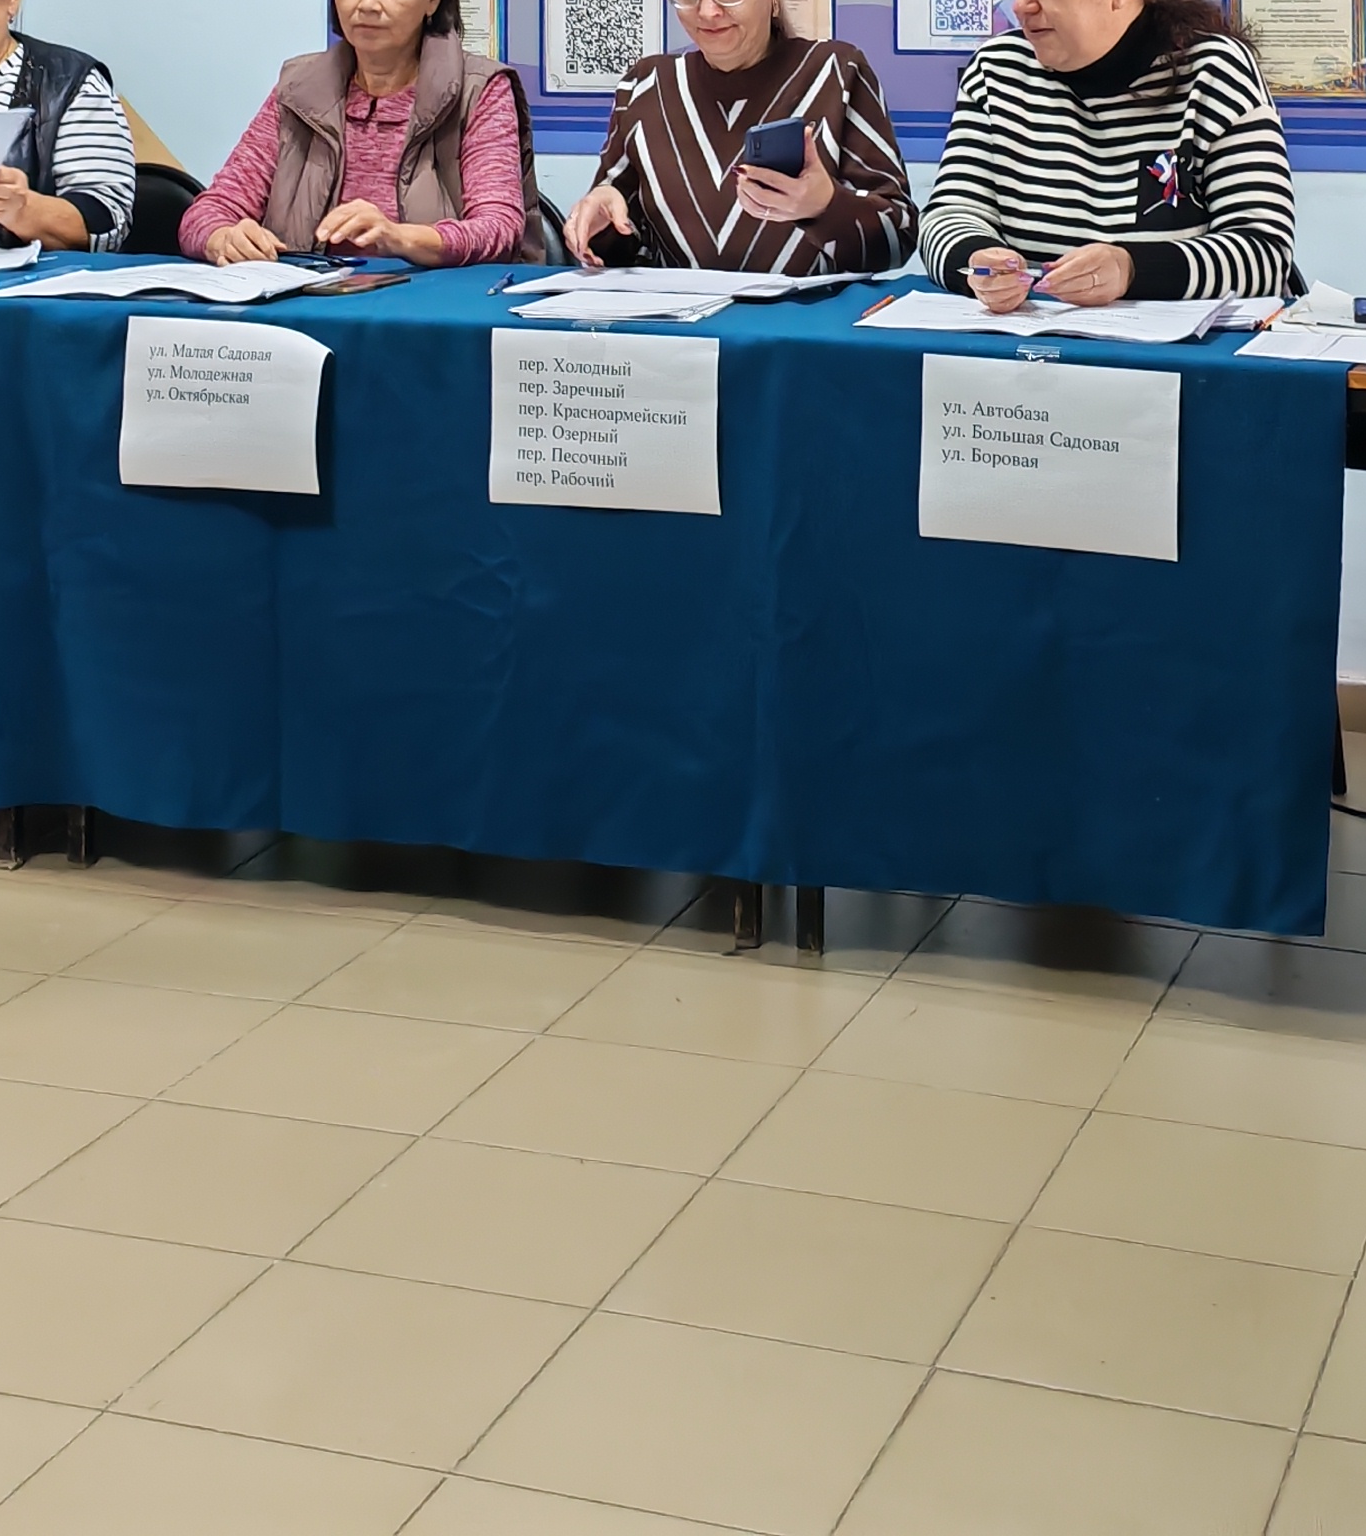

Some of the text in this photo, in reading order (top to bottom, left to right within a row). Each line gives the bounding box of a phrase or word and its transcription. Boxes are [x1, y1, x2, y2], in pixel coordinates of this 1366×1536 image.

[149, 344, 272, 361] ул. Малая Садовая
[148, 365, 253, 383] ул. Молодежная
[519, 358, 632, 376] пер. Холодный
[146, 387, 250, 406] ул. Октябрьская
[519, 380, 625, 399] пер. Заречный
[518, 402, 687, 426] пер. Красноармейский
[942, 401, 1049, 422] ул. Автобаза
[518, 425, 618, 444] пер. Озерный
[942, 424, 1120, 452] ул. Большая Садовая
[517, 447, 628, 467] пер. Песочный
[941, 447, 1039, 468] ул. Боровая
[516, 470, 615, 488] пер. Рабочий
